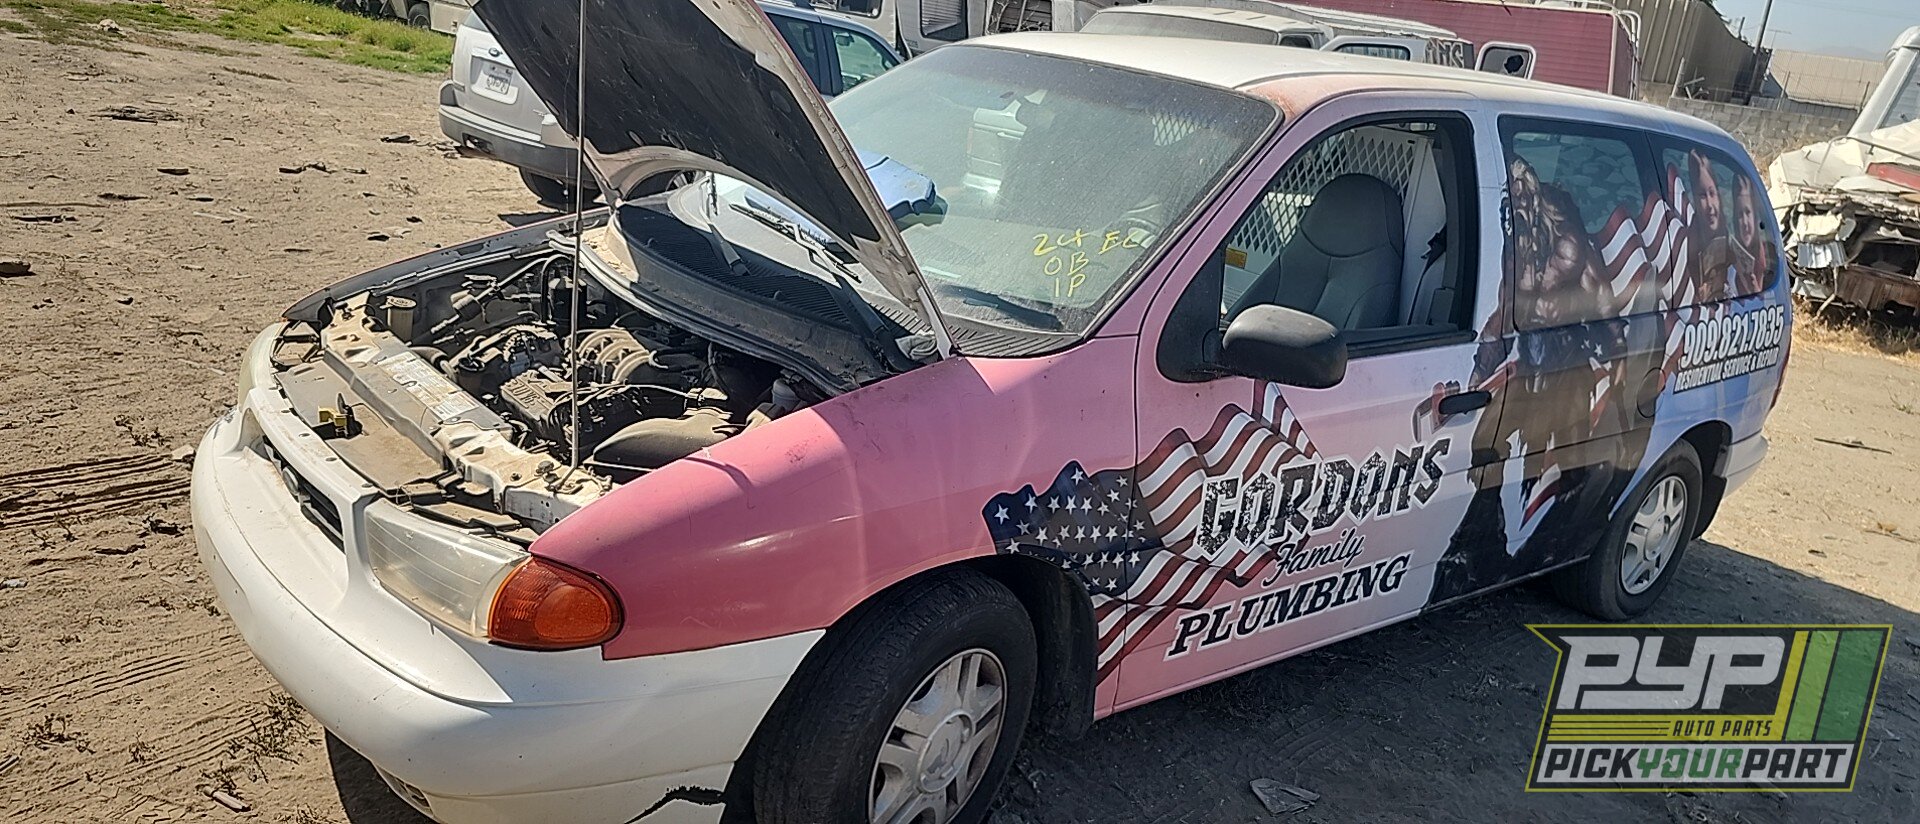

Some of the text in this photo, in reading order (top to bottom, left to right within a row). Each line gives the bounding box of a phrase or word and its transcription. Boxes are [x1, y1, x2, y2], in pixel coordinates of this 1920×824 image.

[1680, 306, 1785, 369] 909.821.7835
[1674, 346, 1780, 393] RESIDENTIAL SERVICE & REPAIR
[1196, 437, 1451, 555] GORDONS
[1262, 528, 1366, 587] Family
[1167, 553, 1411, 657] PLUMBING
